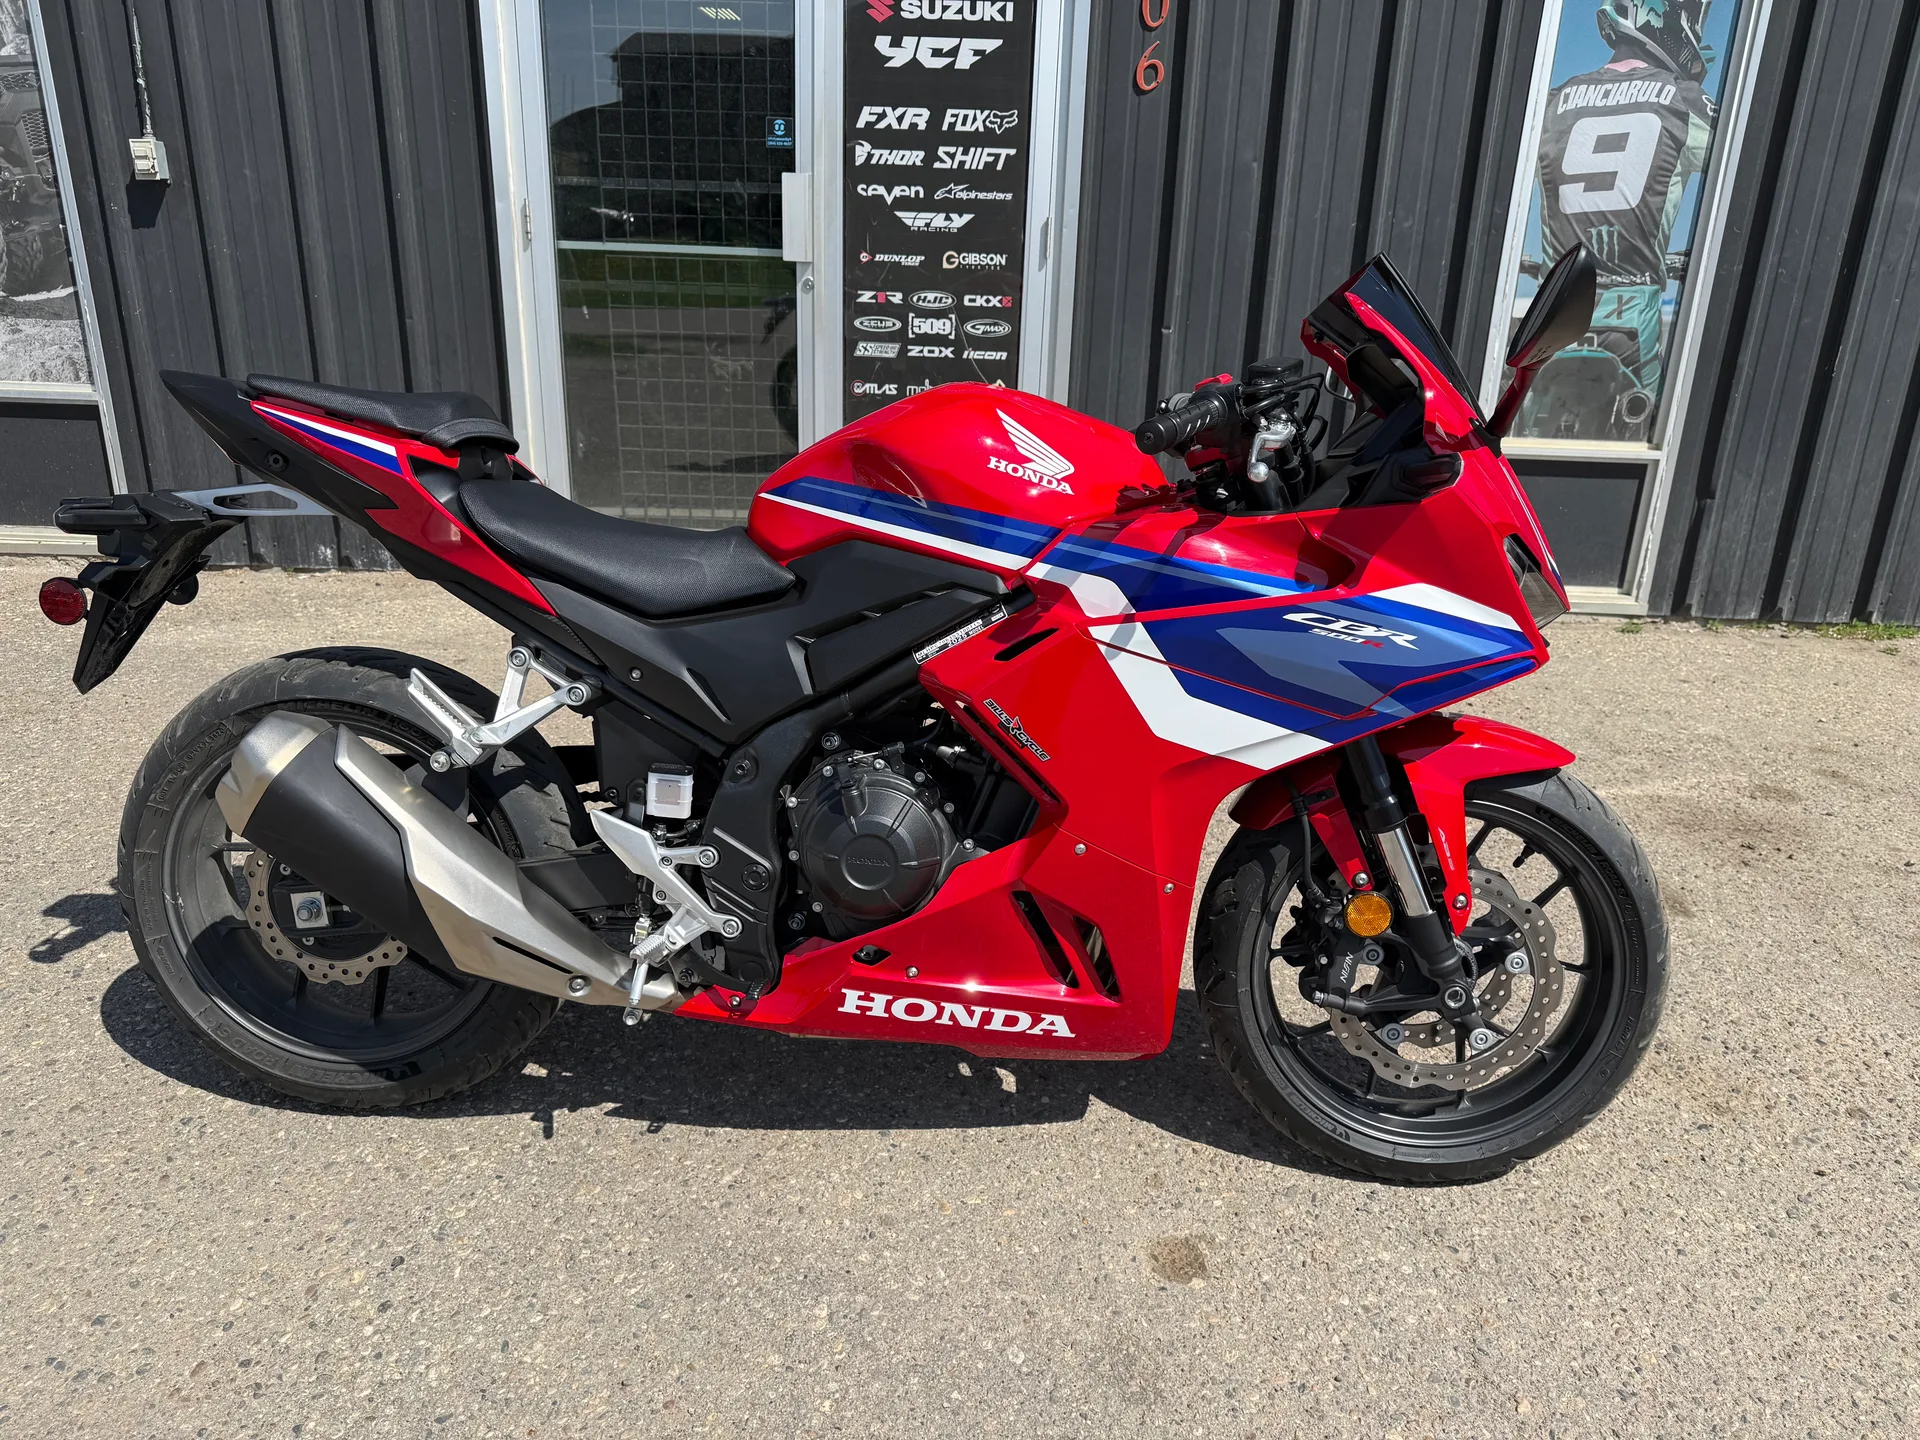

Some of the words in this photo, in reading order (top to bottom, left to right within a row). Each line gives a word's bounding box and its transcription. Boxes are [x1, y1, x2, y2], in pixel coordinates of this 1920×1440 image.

[900, 0, 1014, 22] SUZUKI
[873, 35, 1003, 70] YCF
[1556, 80, 1676, 115] CIANCIARULO
[855, 105, 931, 131] FXR
[941, 108, 991, 132] FOX
[870, 149, 926, 166] THOR
[932, 146, 1017, 171] SHIFT
[1558, 112, 1662, 215] 9
[955, 190, 1014, 201] alpinestars
[874, 253, 925, 263] DUNLOP
[959, 252, 1006, 266] GIBSON
[856, 290, 904, 304] Z1R
[915, 295, 952, 305] HJC
[963, 294, 1003, 308] CKX
[907, 345, 955, 358] ZOX
[987, 456, 1075, 496] HONDA
[1282, 612, 1420, 651] CBR
[1308, 628, 1385, 649] 500R
[1016, 730, 1050, 762] CYCLE
[847, 856, 891, 868] HONDA
[837, 988, 1076, 1038] HONDA
[230, 1030, 279, 1071] ROAD
